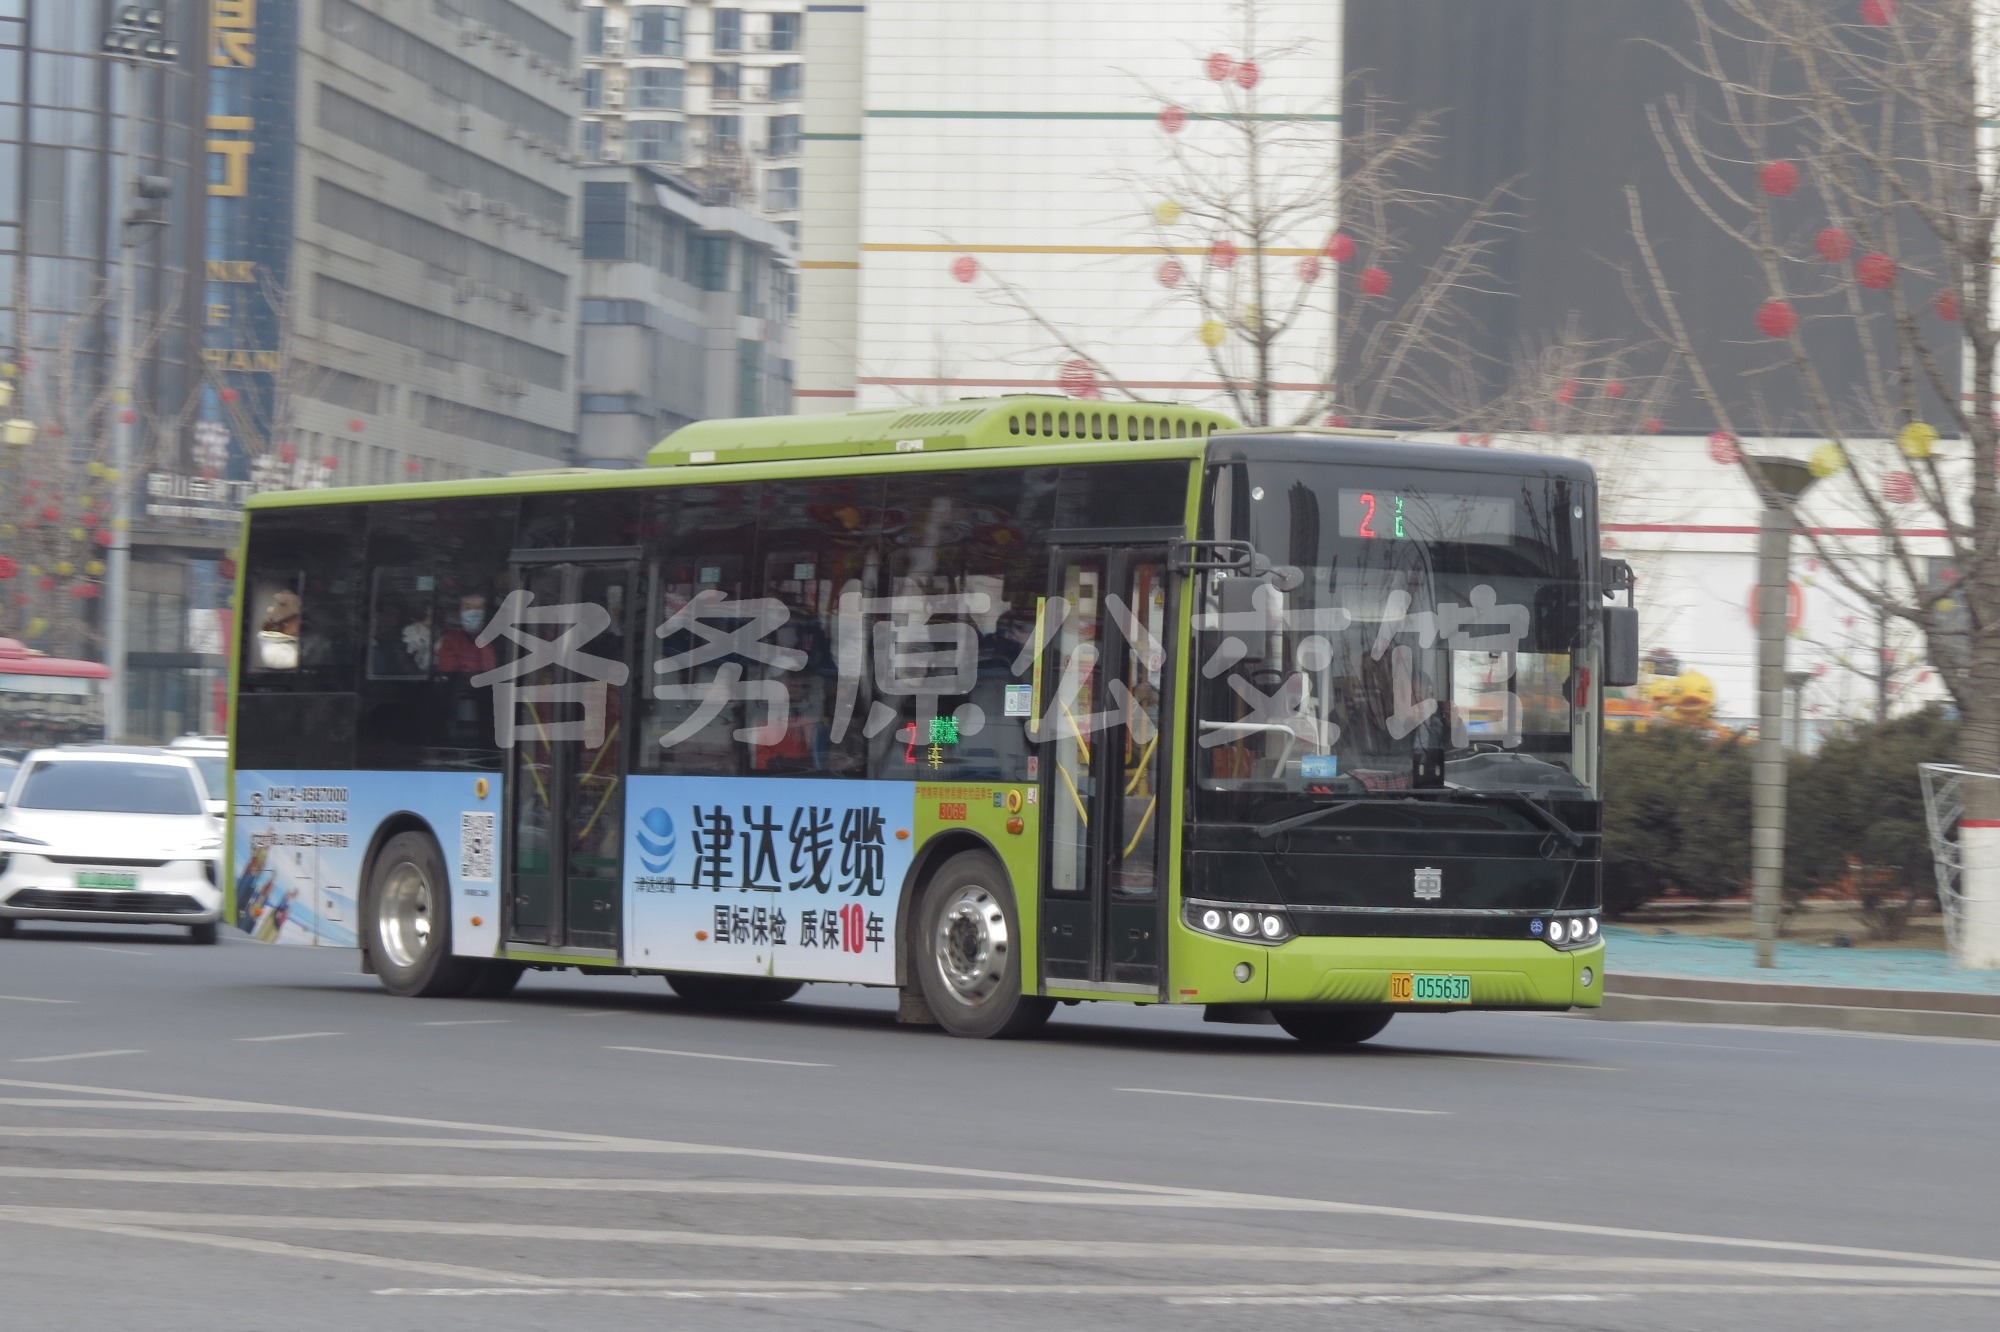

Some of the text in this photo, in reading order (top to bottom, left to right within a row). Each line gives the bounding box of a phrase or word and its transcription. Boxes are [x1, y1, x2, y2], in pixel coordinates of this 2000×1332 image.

[1360, 493, 1375, 537] 2
[905, 722, 918, 764] 2
[940, 804, 965, 820] 3069
[691, 804, 886, 896] 津达线缆
[800, 903, 885, 953] 质保10年
